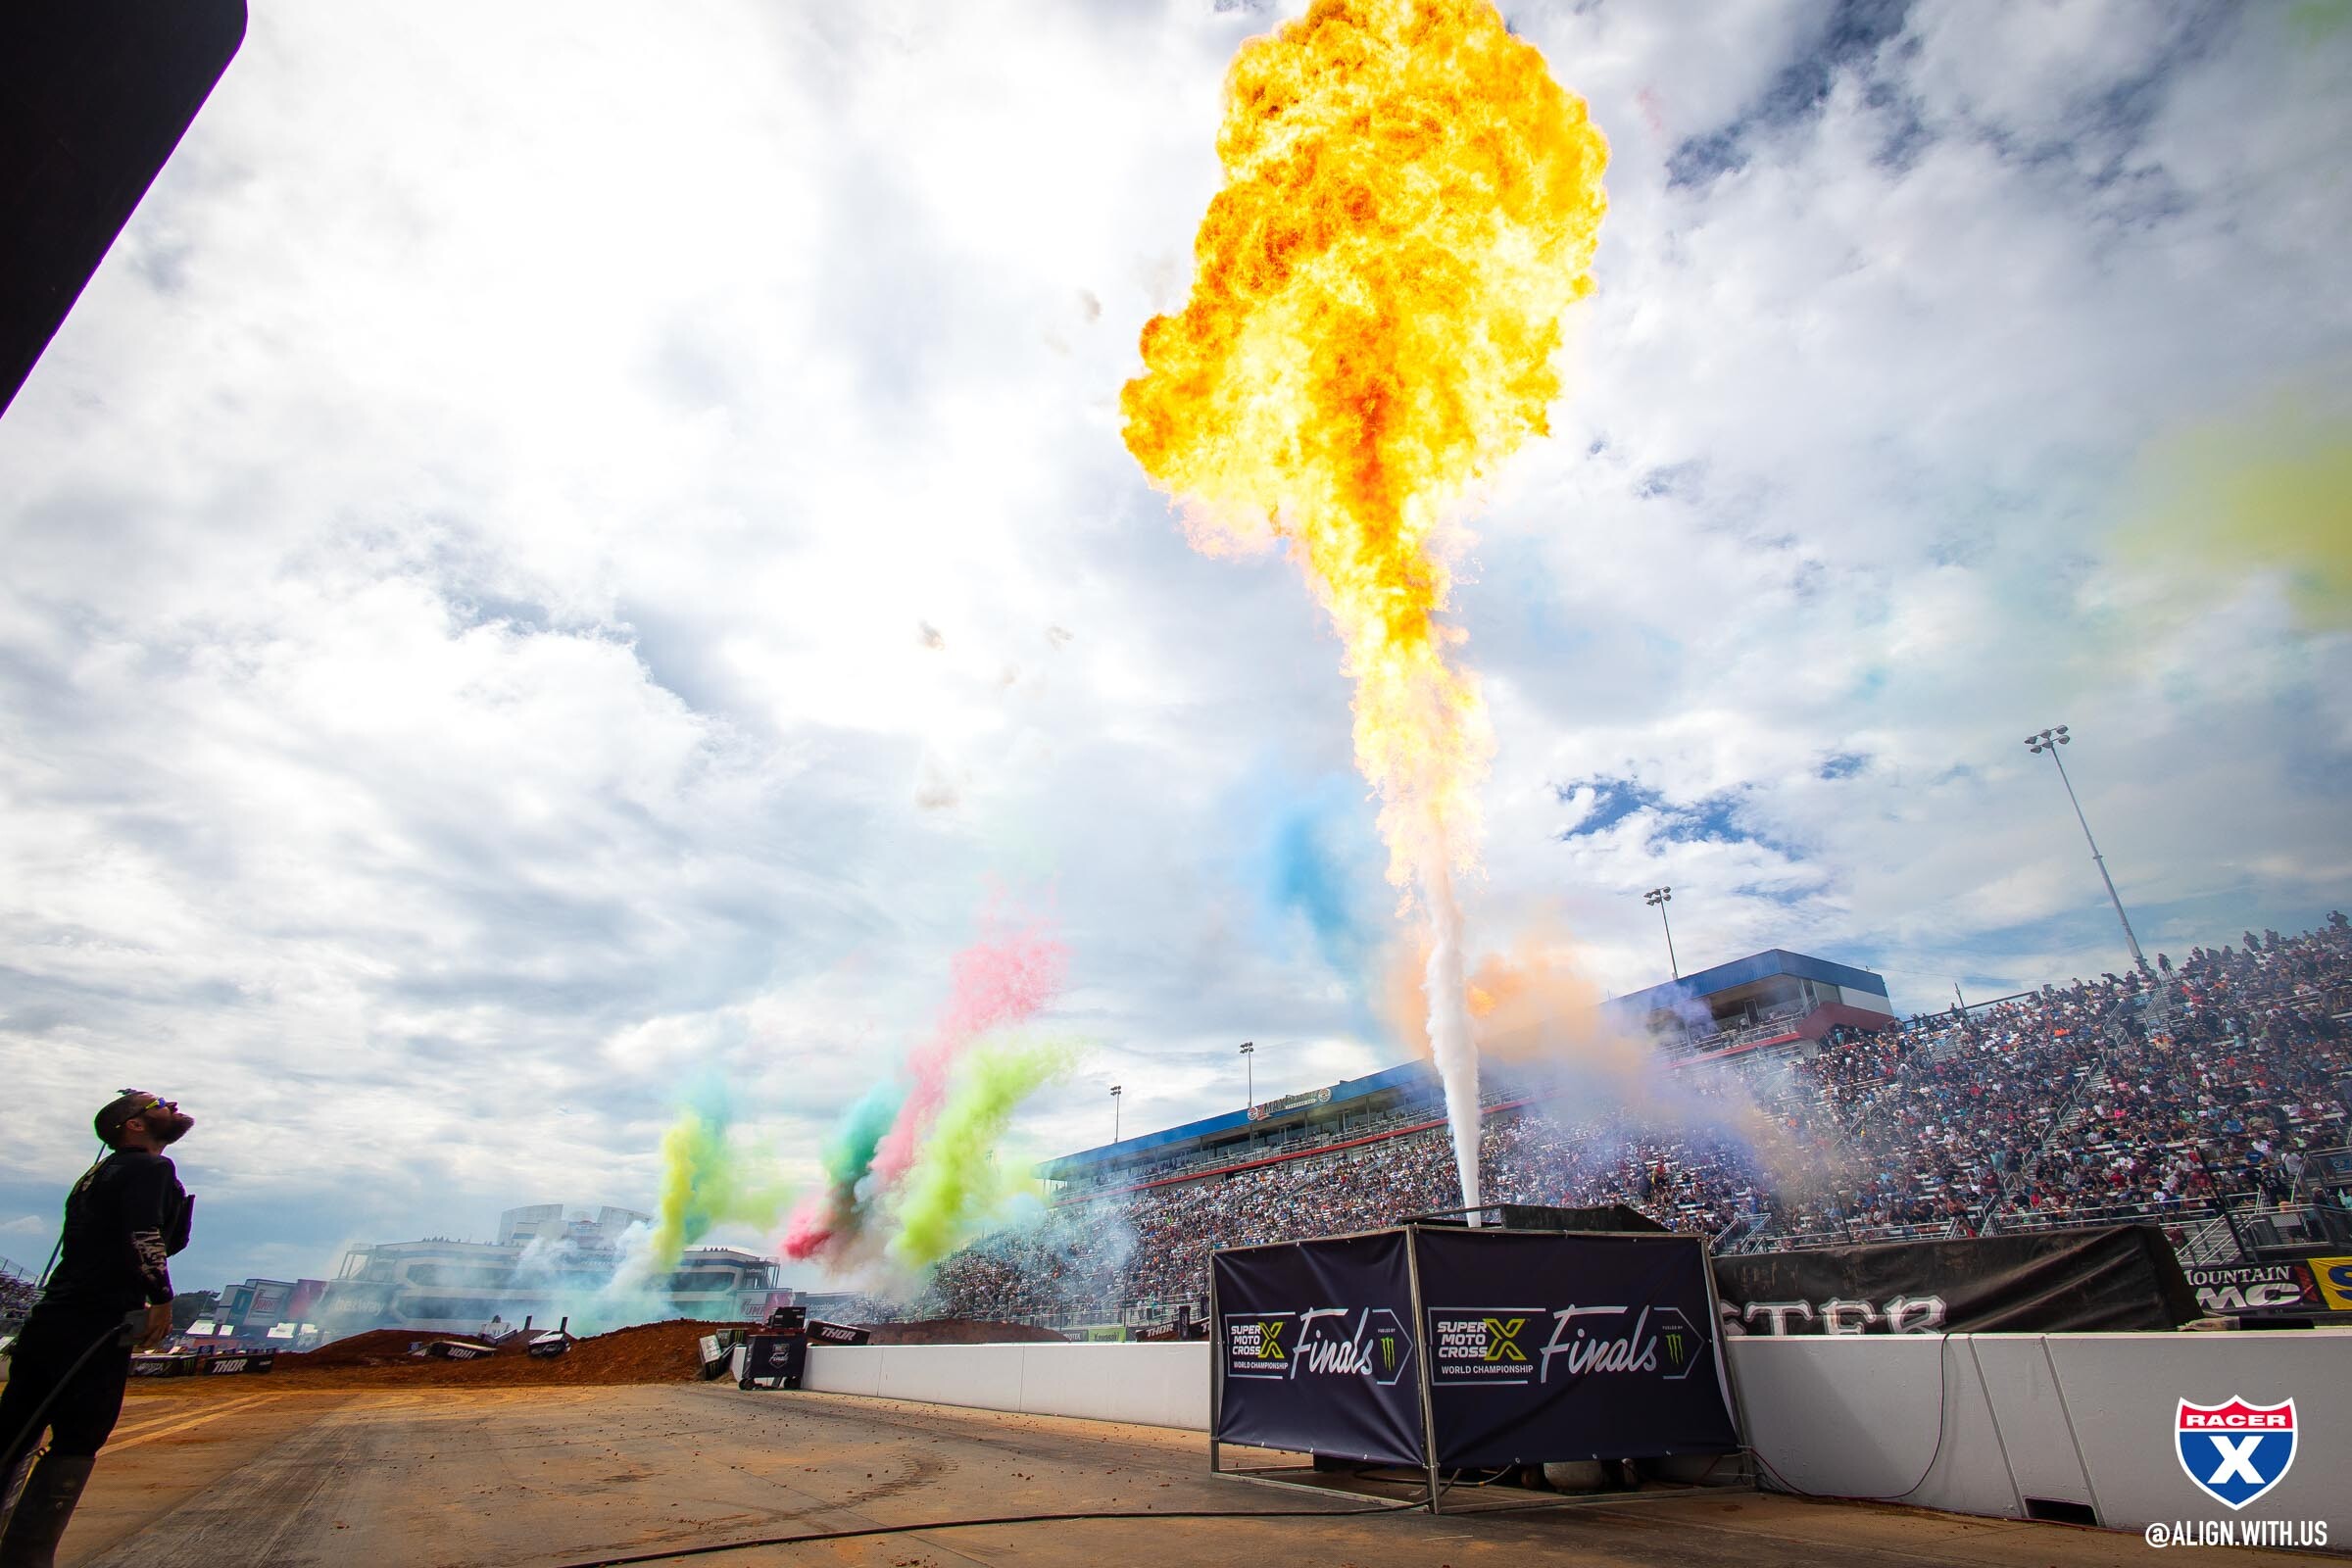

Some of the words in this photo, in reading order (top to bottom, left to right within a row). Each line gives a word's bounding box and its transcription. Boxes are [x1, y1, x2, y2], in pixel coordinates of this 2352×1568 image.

[1146, 1323, 1174, 1338] THOR
[1231, 1325, 1261, 1335] SUPER
[1437, 1321, 1488, 1333] SUPER
[820, 1326, 857, 1341] THOR
[1234, 1336, 1260, 1345] MOTO
[1291, 1306, 1373, 1380] Finals
[1442, 1334, 1485, 1346] MOTO
[1540, 1303, 1657, 1384] Finals
[1232, 1346, 1261, 1355] CROSS
[1439, 1346, 1488, 1358] CROSS
[213, 1359, 247, 1373] THOR
[1234, 1360, 1250, 1369] WORLD
[1250, 1360, 1289, 1370] CHAMPIONSHIP
[1442, 1365, 1471, 1374] WORLD
[1473, 1364, 1534, 1374] CHAMPIONSHIP
